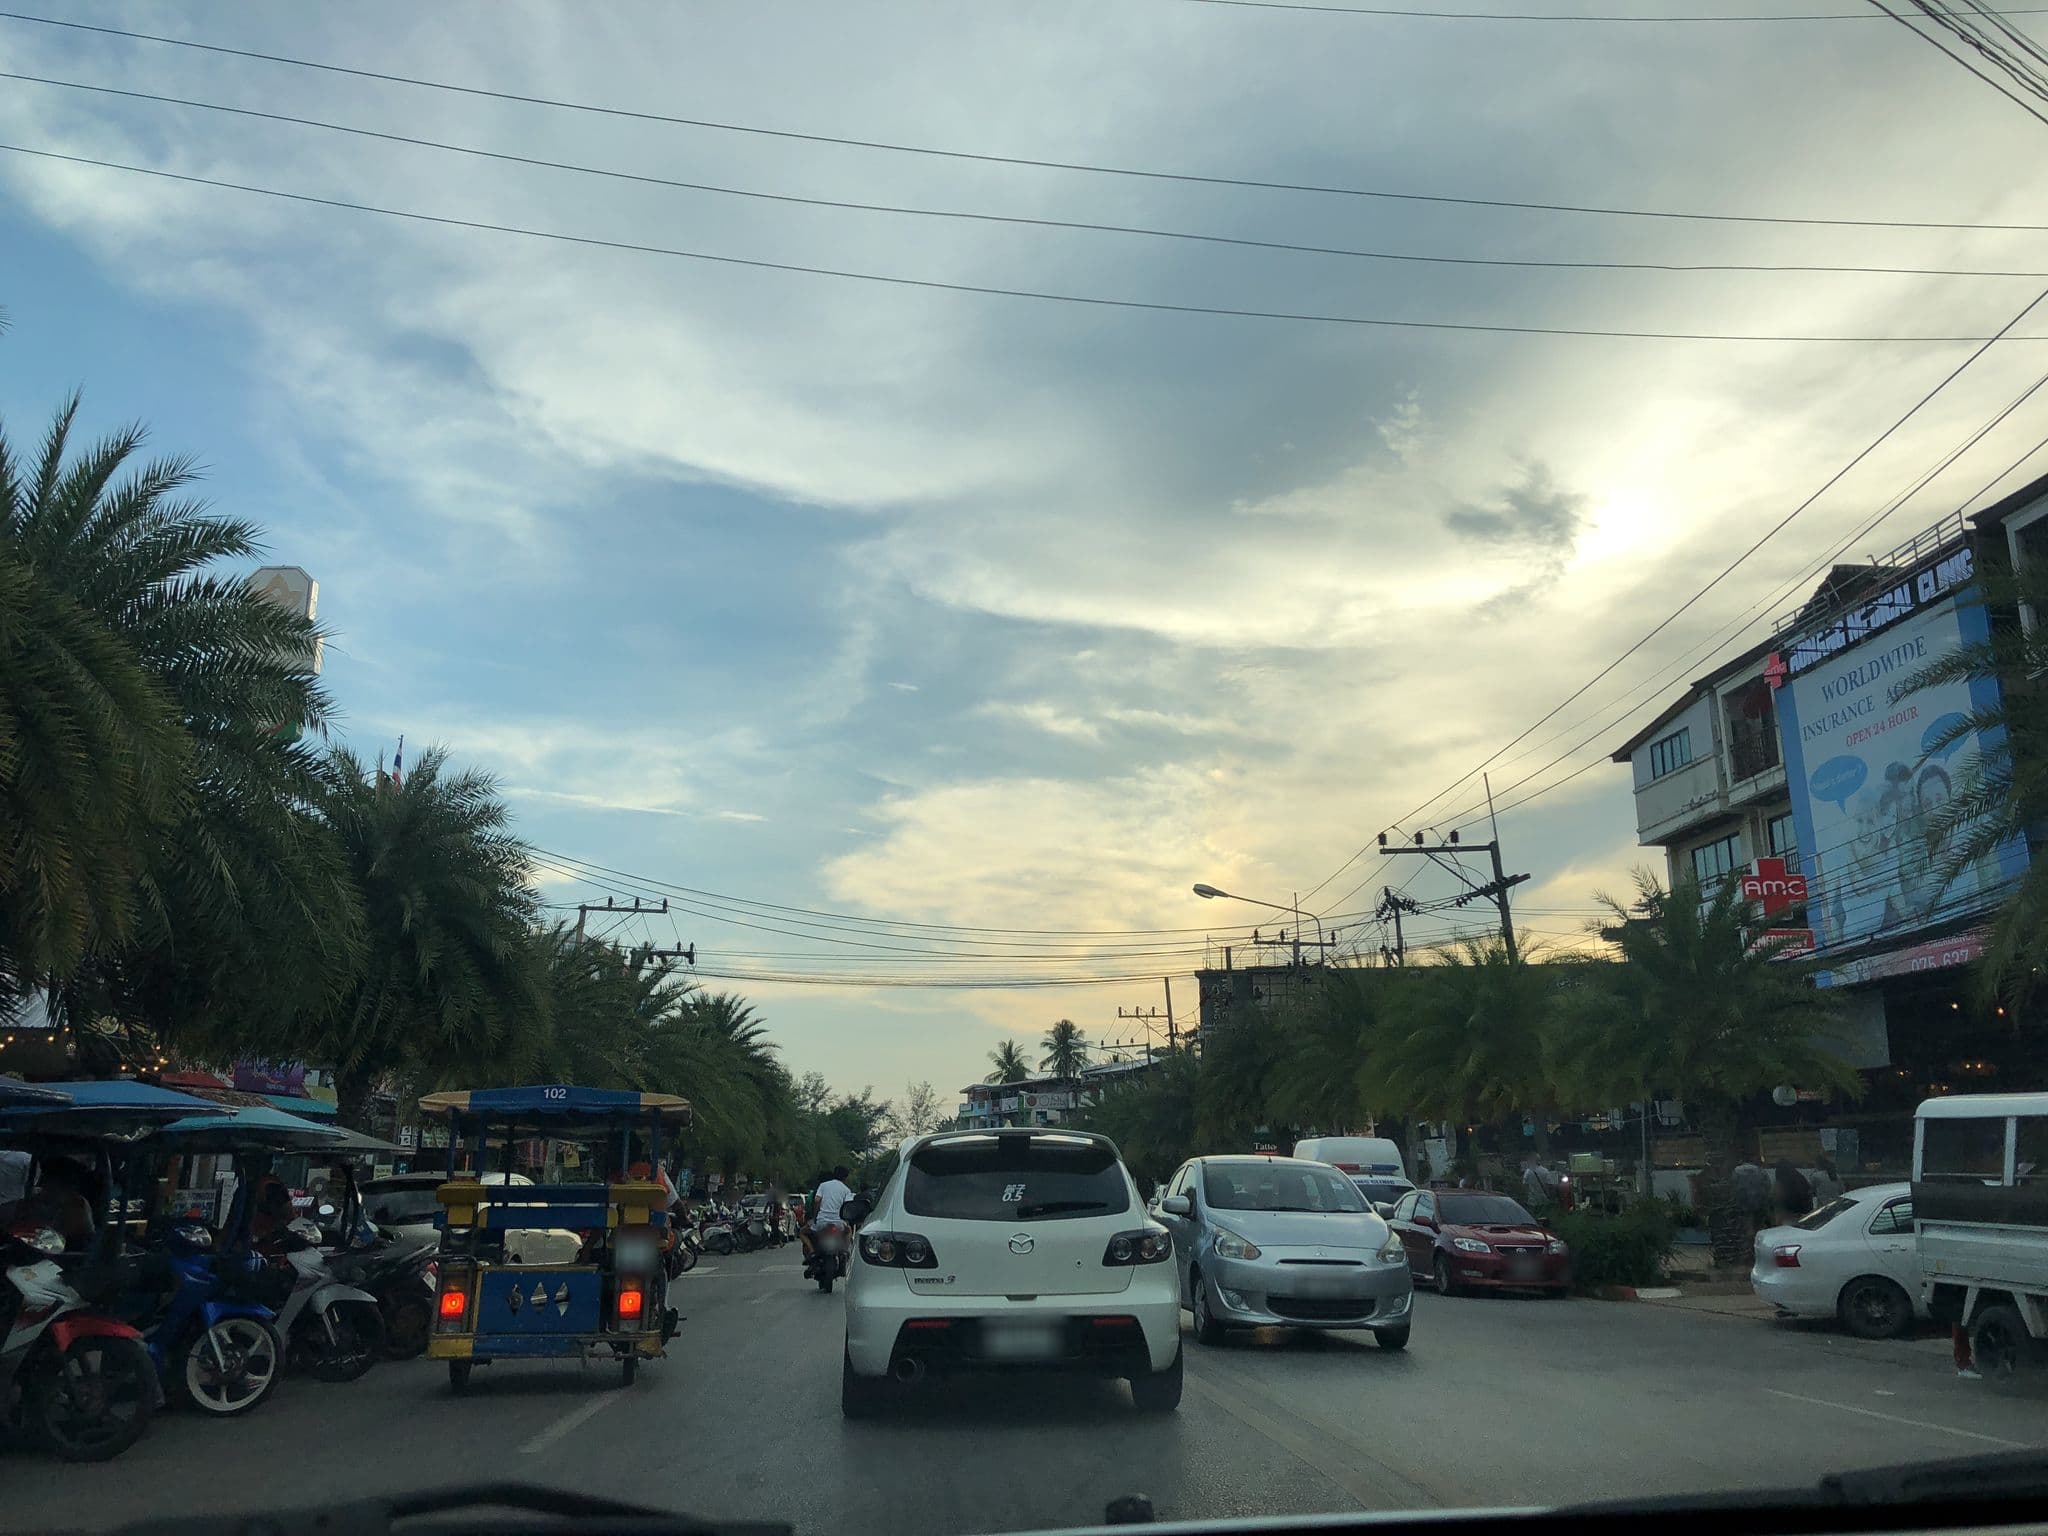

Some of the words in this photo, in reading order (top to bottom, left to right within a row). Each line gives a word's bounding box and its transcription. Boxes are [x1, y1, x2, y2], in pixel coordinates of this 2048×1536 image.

[1917, 549, 1974, 603] CLINIC
[1822, 635, 1928, 704] WORLDWIDE
[1802, 695, 1876, 742] INSURANCE
[1846, 724, 1872, 748] OPEN
[1872, 721, 1887, 738] 24
[1887, 706, 1920, 730] HOUR
[543, 1088, 567, 1099] 102
[1002, 1191, 1023, 1201] 0.5
